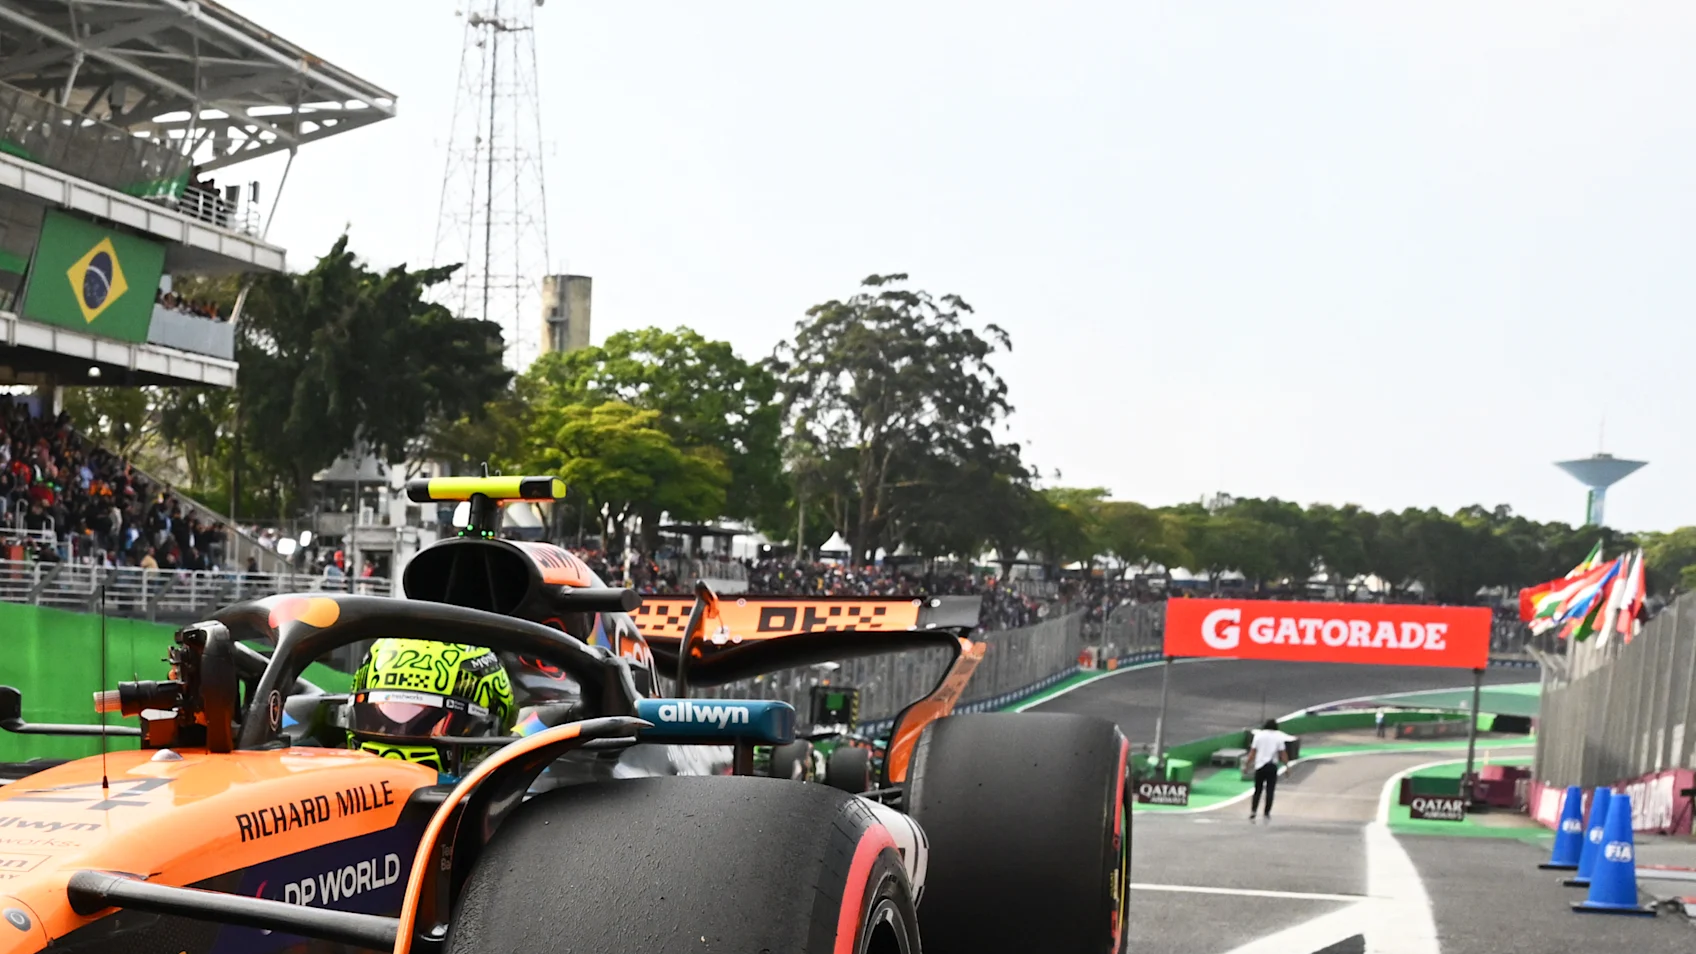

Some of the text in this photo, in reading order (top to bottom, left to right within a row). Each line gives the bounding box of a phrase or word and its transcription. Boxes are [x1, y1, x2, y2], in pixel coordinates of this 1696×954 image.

[1248, 616, 1448, 650] GATORADE
[658, 702, 749, 729] allwyn
[1139, 783, 1187, 798] QATAR
[235, 780, 394, 843] RICHARD MILLE
[1412, 797, 1464, 813] QATAR
[1605, 842, 1633, 861] FIA
[284, 877, 316, 906] DP
[318, 853, 401, 905] WORLD
